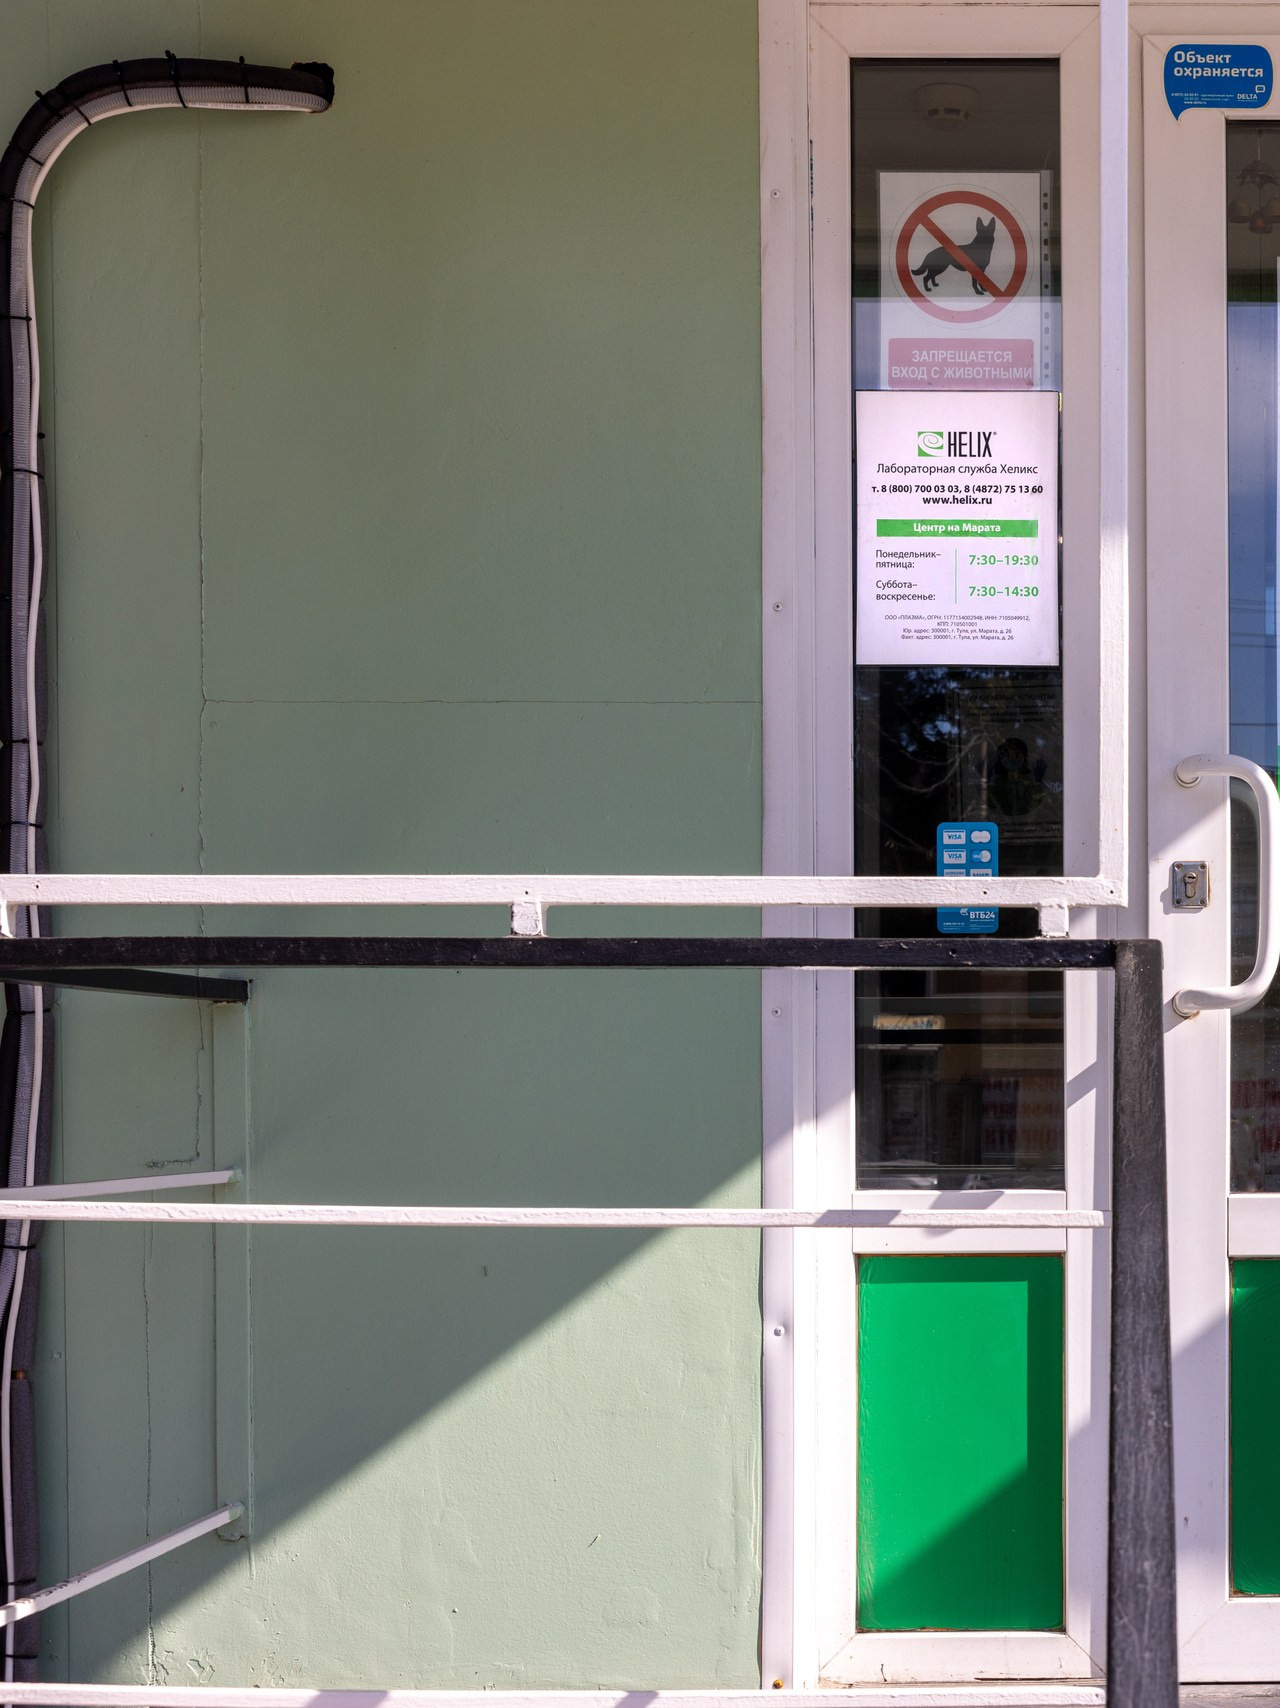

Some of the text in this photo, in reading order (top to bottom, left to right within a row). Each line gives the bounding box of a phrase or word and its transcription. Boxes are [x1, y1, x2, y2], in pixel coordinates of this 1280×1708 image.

[1173, 50, 1232, 64] Объект
[1173, 66, 1264, 79] охраняется
[912, 350, 1012, 364] ЗАПРЕЩАЕТСЯ
[891, 366, 1033, 380] ВХОД С ЖИВОТНЫМИ
[947, 431, 993, 458] HELIX
[876, 463, 1038, 475] Лабораторная служба Хеликс
[881, 485, 887, 493] 8
[888, 485, 912, 494] (800)
[915, 485, 932, 493] 700
[934, 485, 945, 493] 03
[947, 485, 962, 495] 03,
[964, 485, 970, 494] 8
[972, 485, 1002, 495] (4872)
[1005, 485, 1016, 494] 75
[1019, 486, 1030, 494] 13
[1032, 486, 1043, 494] 60
[922, 495, 993, 505] www.helix.ru
[913, 523, 945, 533] Центр
[962, 523, 1001, 533] Марата
[875, 561, 915, 570] пятница:
[968, 554, 1039, 566] 7:30–19:30
[968, 586, 1039, 597] 7:30–14:30
[875, 593, 936, 603] воскресенье:
[970, 911, 995, 919] ВТБ24
